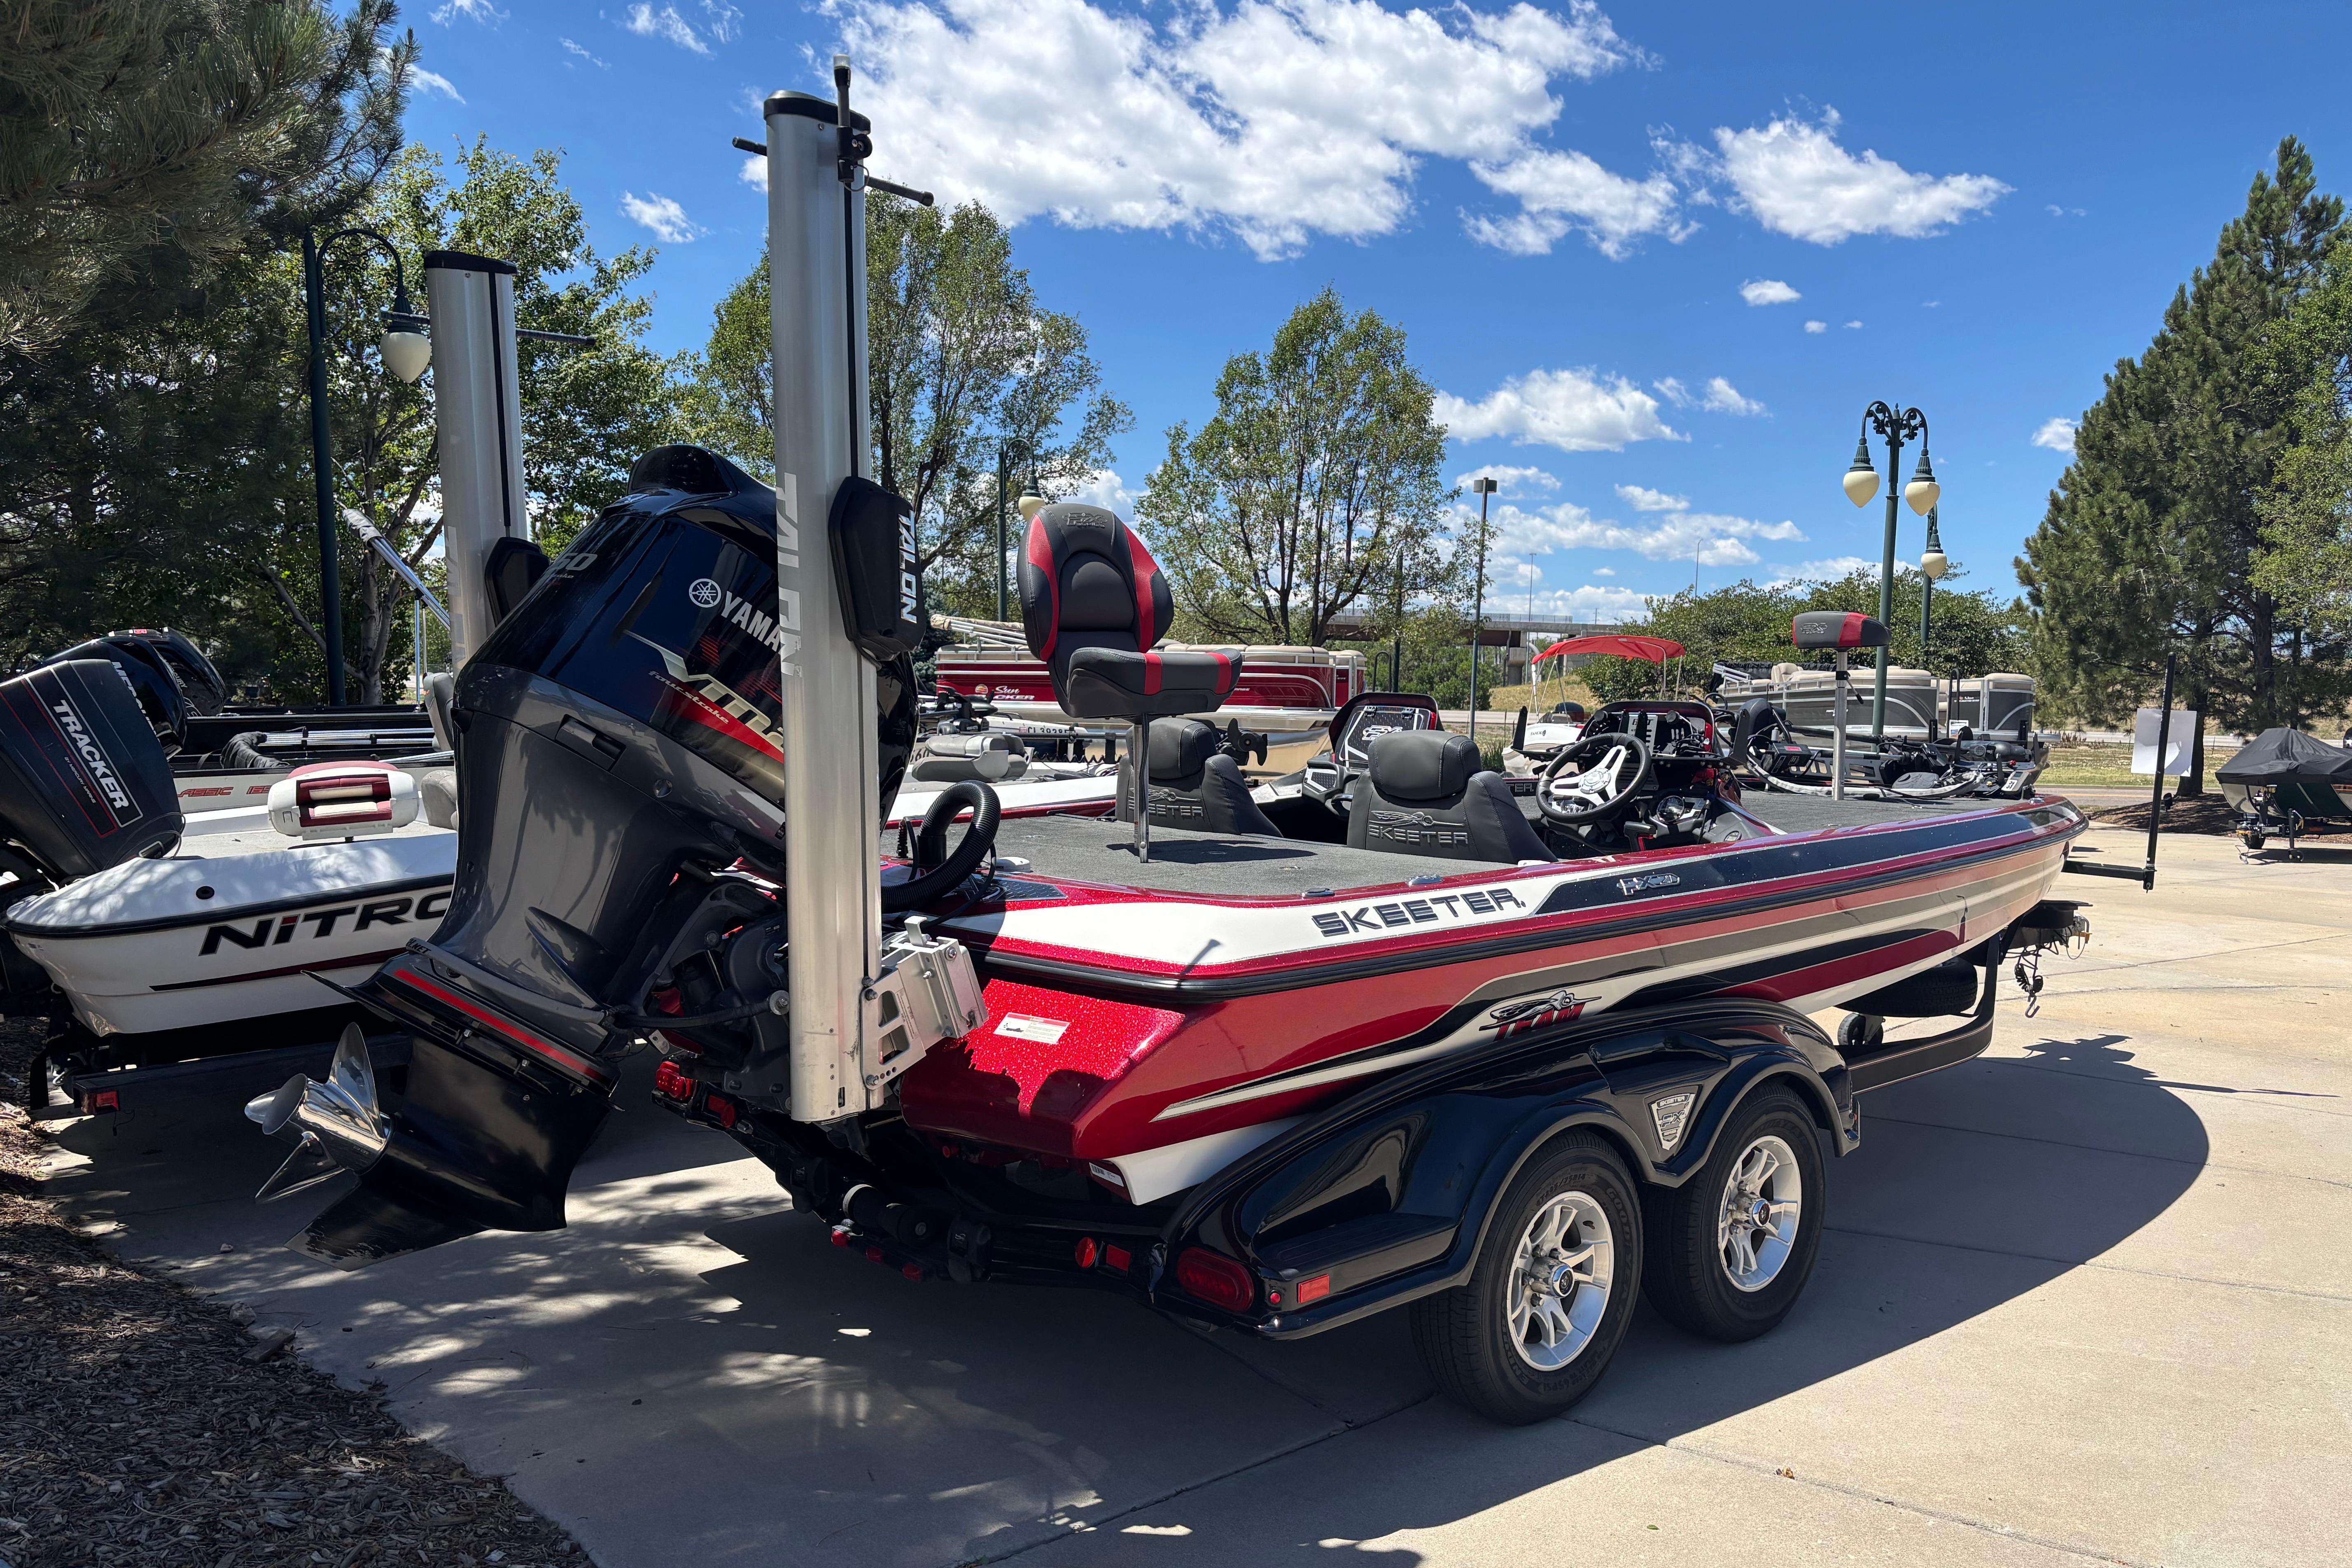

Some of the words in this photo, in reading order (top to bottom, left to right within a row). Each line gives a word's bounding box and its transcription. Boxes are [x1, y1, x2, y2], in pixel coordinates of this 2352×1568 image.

[898, 509, 917, 624] TALON
[721, 590, 782, 655] YAMA
[53, 700, 129, 808] TRACKER
[69, 764, 84, 785] MERCURY
[83, 786, 97, 803] MARINE
[1368, 825, 1468, 844] SKEETER
[1659, 1095, 1686, 1106] SKEETER
[1660, 1111, 1686, 1129] FX
